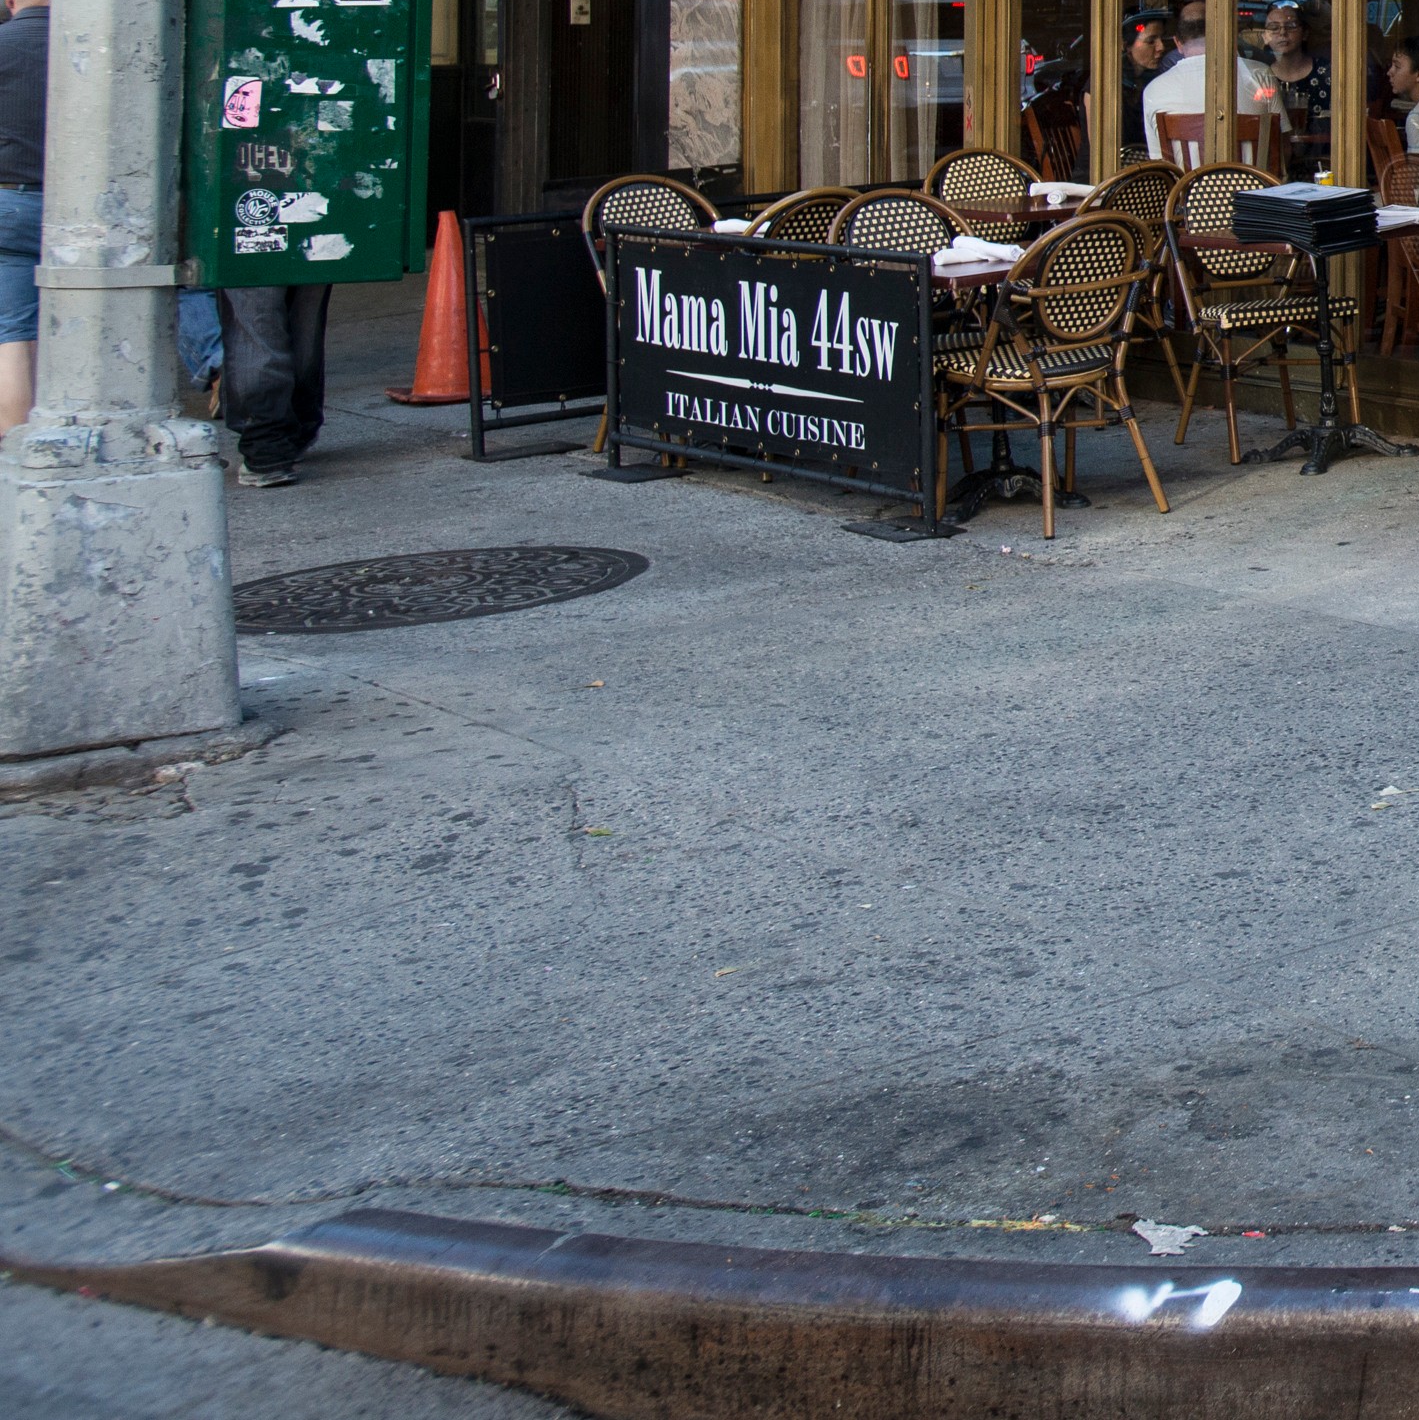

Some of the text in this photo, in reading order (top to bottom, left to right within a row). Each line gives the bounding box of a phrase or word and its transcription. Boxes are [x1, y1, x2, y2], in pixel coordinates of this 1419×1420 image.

[635, 267, 728, 357] Mama
[738, 280, 799, 368] Mia
[665, 391, 865, 450] ITALIAN CUISINE
